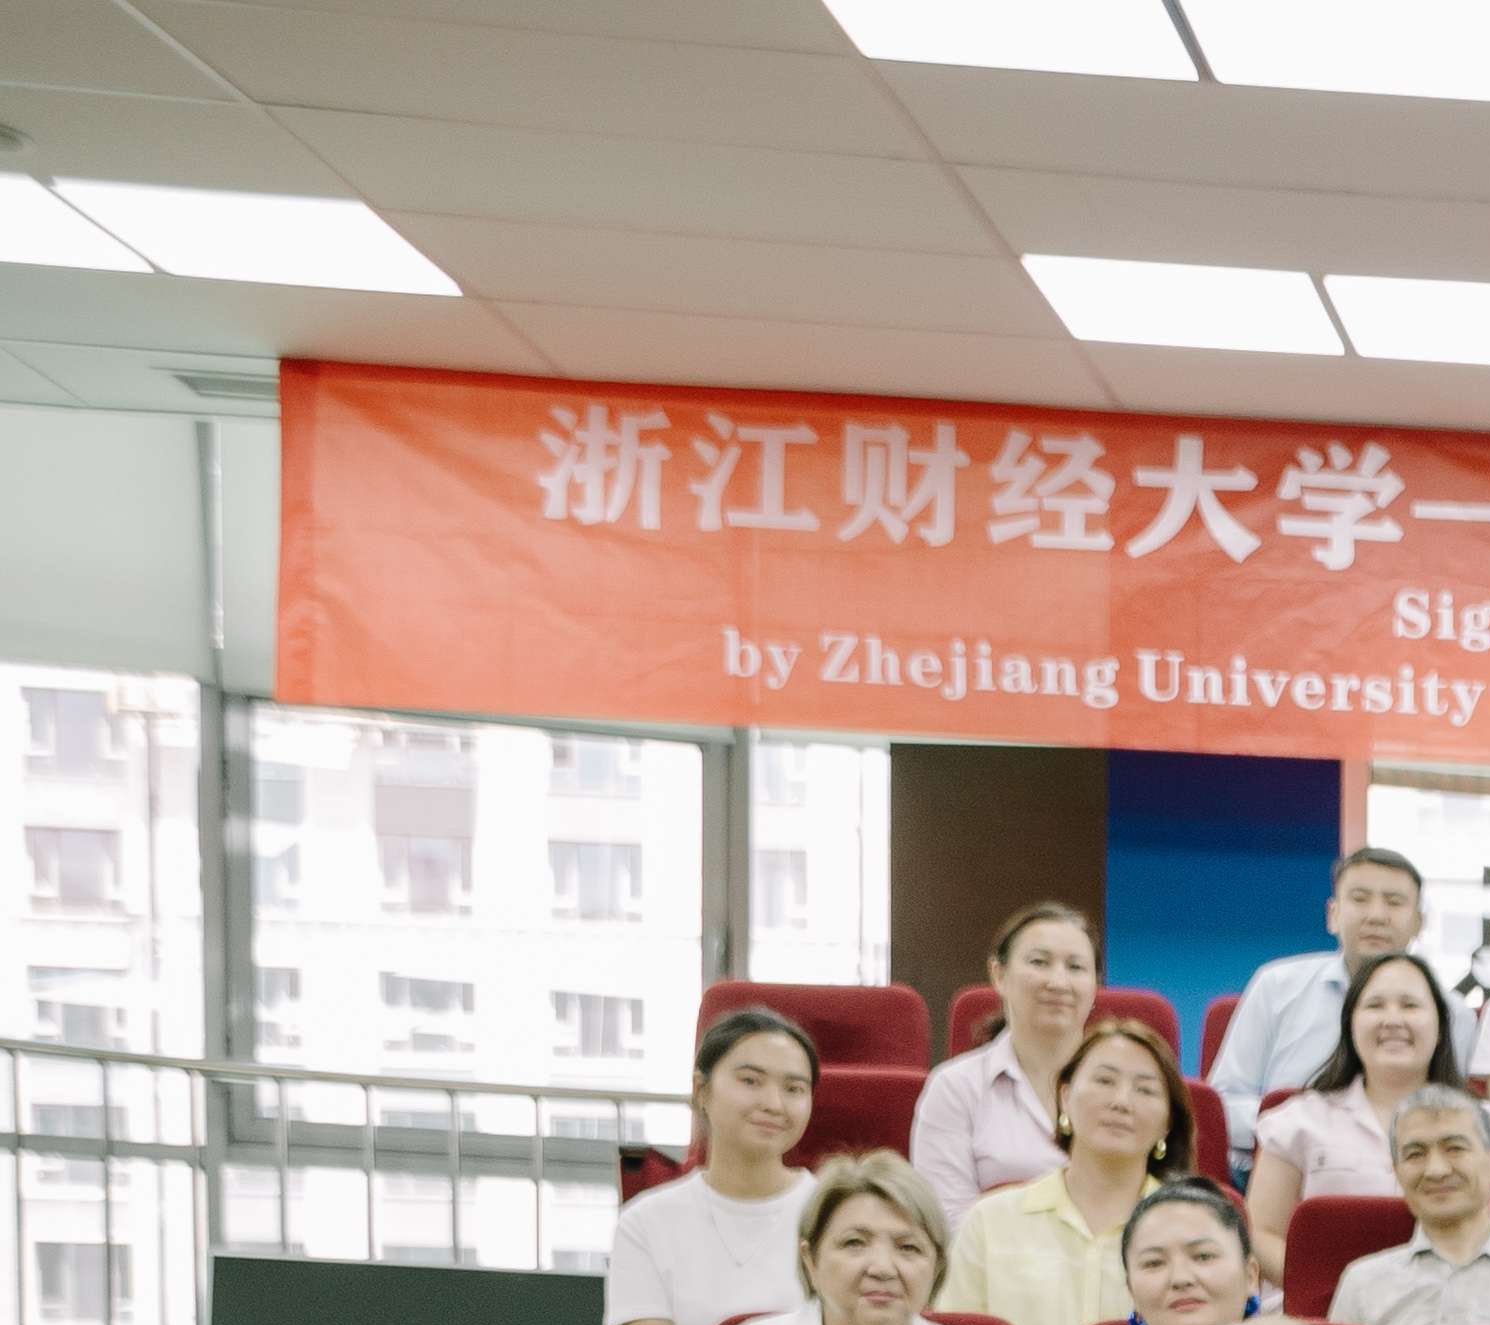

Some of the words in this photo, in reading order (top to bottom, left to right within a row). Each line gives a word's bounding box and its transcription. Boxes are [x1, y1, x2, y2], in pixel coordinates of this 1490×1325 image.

[721, 625, 802, 689] by
[819, 630, 1120, 710] Zhejiang
[1135, 648, 1485, 726] University
